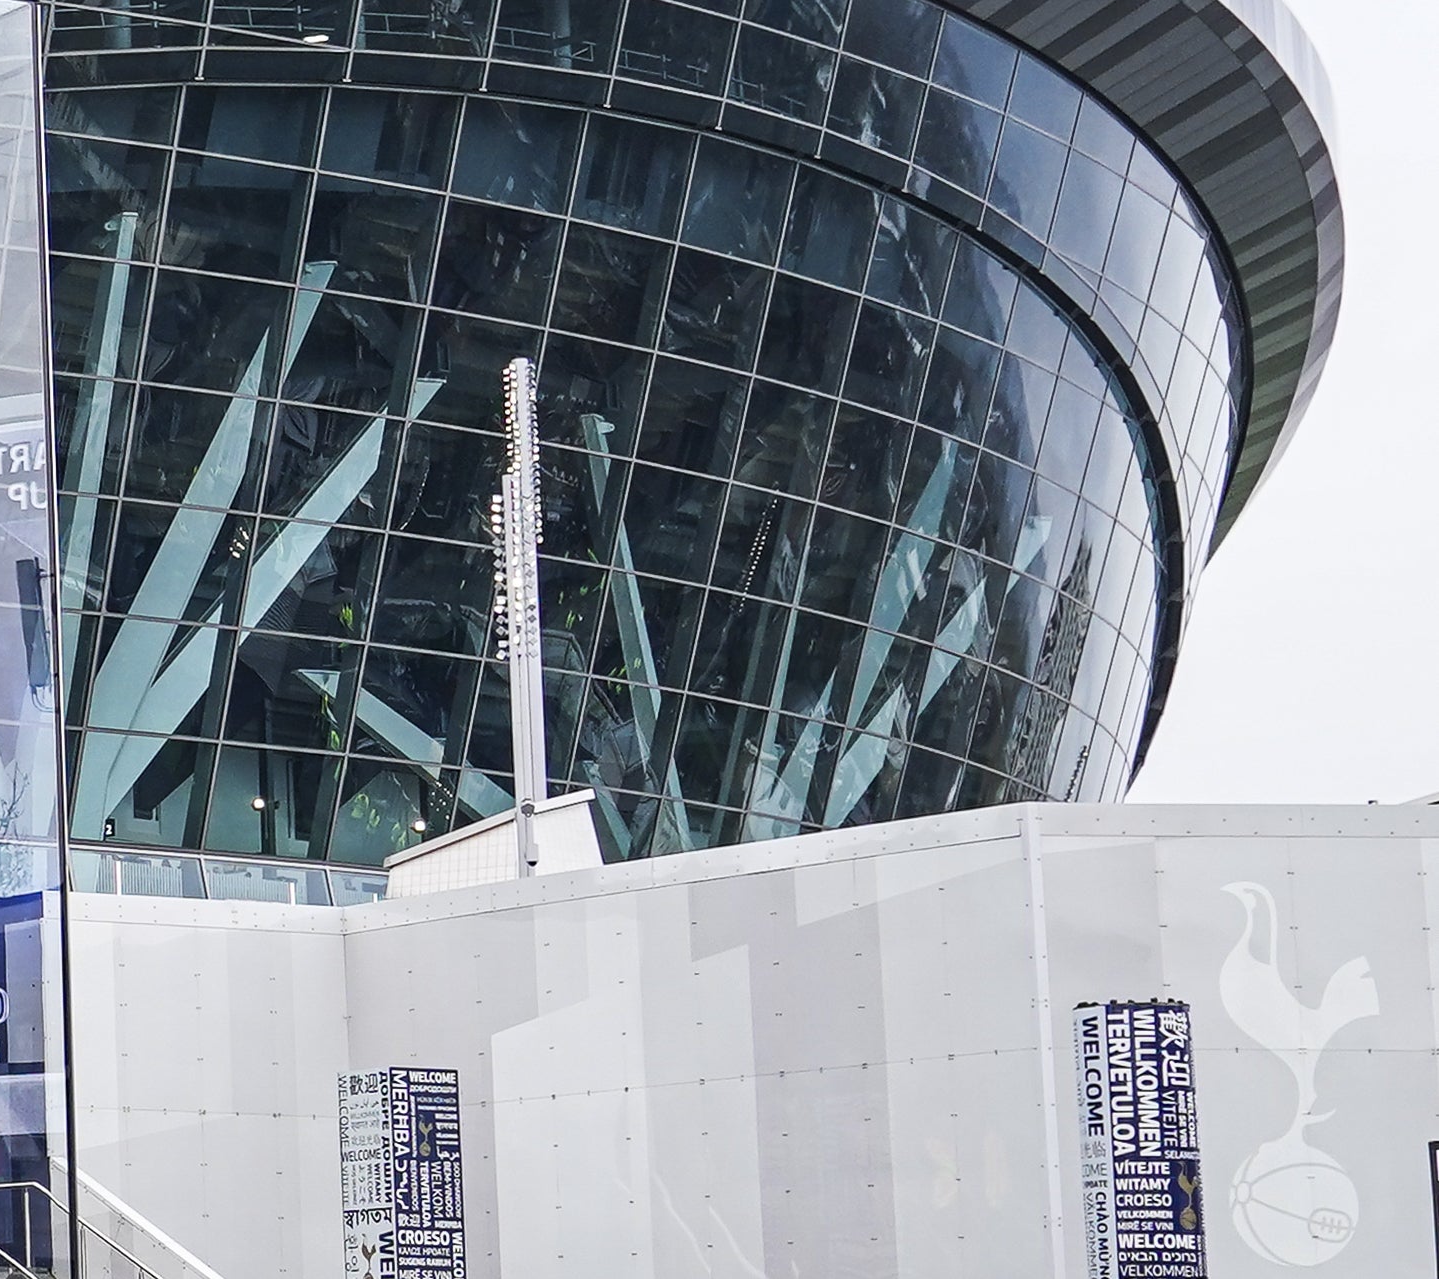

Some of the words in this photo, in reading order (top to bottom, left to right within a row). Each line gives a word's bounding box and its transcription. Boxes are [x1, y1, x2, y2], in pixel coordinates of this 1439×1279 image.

[105, 824, 113, 835] 2
[409, 1070, 457, 1085] WELCOME
[1082, 1016, 1105, 1137] WELCOME
[1107, 1009, 1136, 1157] TERVETULOA
[1133, 1008, 1162, 1157] WILLKOMMEN
[1186, 1091, 1198, 1148] WELCOME
[1115, 1159, 1170, 1175] VÍTEJTE
[373, 1162, 382, 1203] WITAMY
[431, 1161, 444, 1219] WELKOM
[1115, 1178, 1171, 1191] WITAMY
[419, 1160, 432, 1228] TERVETULOA
[1116, 1194, 1172, 1207] CROESO
[1141, 1221, 1154, 1231] SE
[1154, 1221, 1174, 1231] VINI
[398, 1230, 451, 1246] CROESO
[1118, 1234, 1197, 1249] WELCOME
[1119, 1264, 1201, 1278] VELKOMMEN
